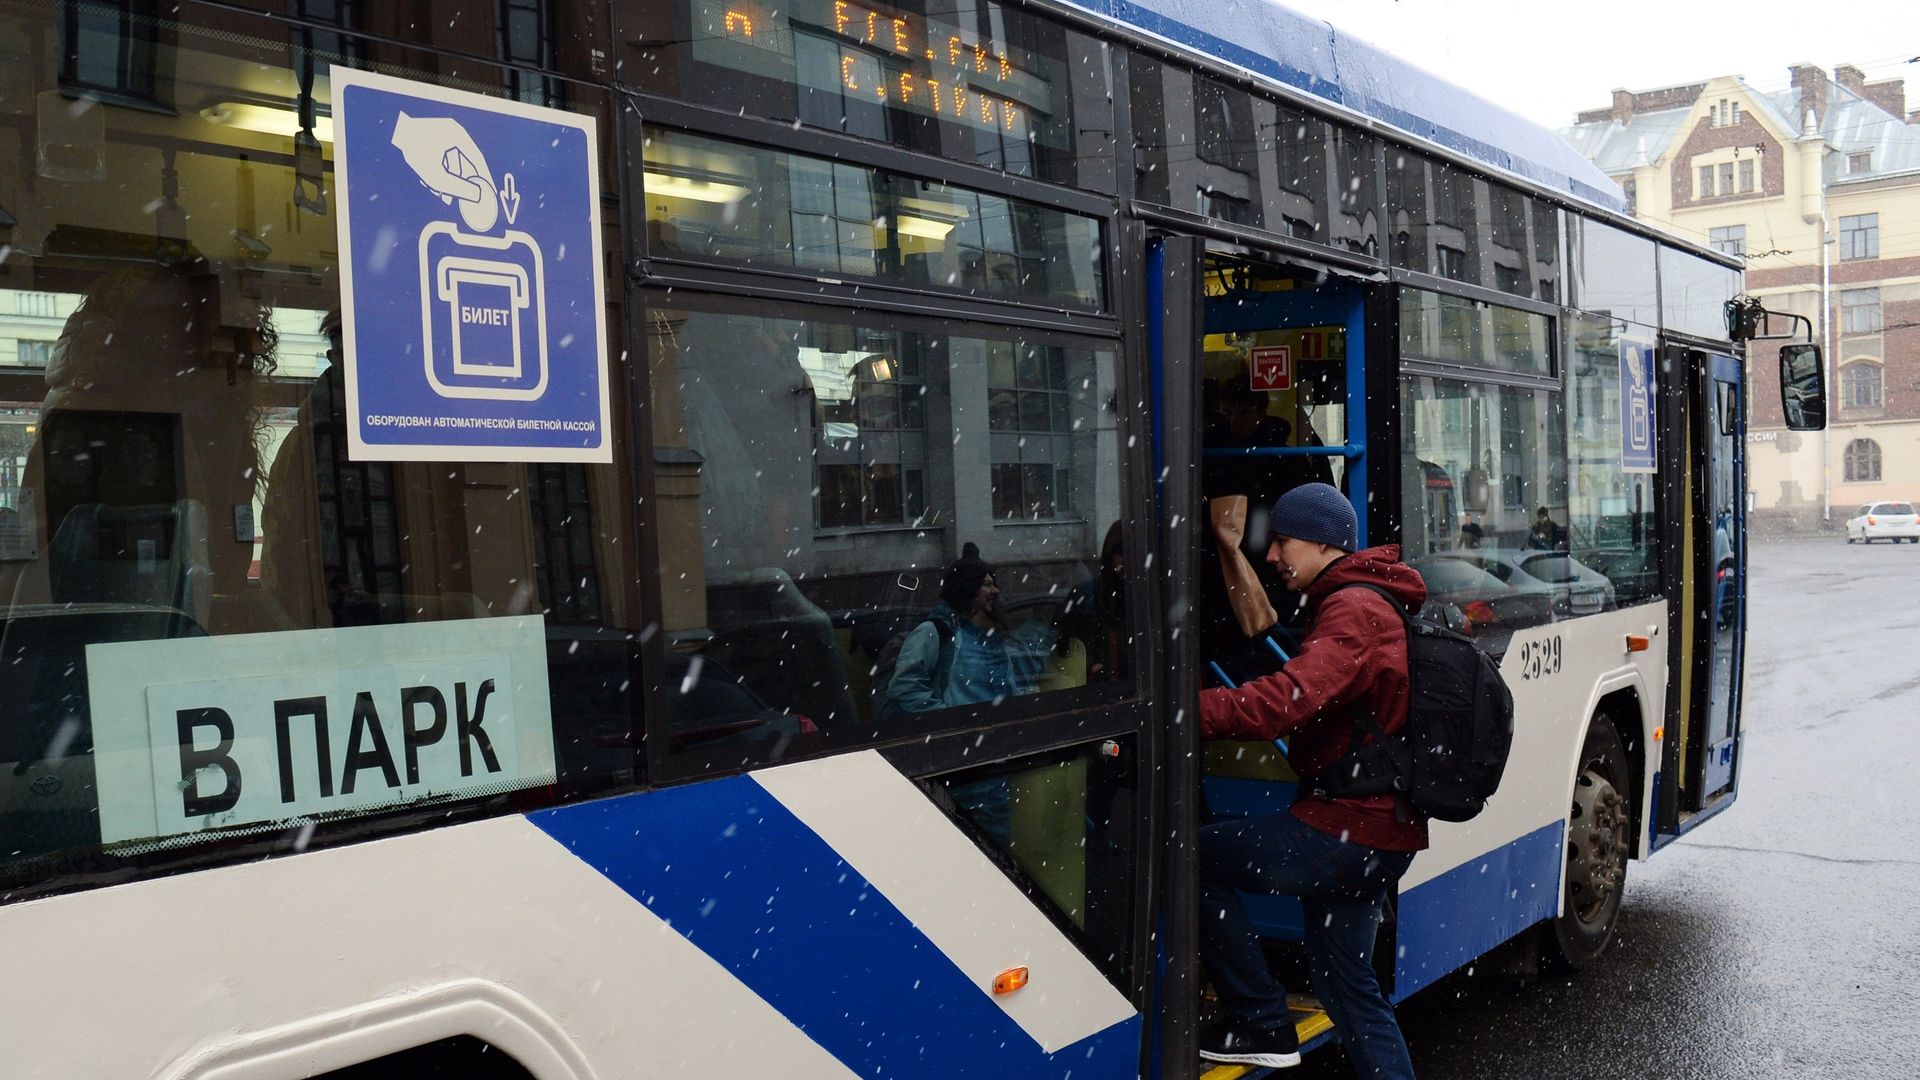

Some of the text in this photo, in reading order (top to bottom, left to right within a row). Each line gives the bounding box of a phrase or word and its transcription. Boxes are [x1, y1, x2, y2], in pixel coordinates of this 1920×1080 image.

[461, 306, 509, 326] БИЛЕТ
[366, 415, 596, 432] ОБОРУДОВАН АВТОМАТИЧЕСКОЙ БИЛЕТНОЙ КАССОЙ
[1520, 634, 1562, 681] 2329
[176, 678, 502, 818] В ПАРК
